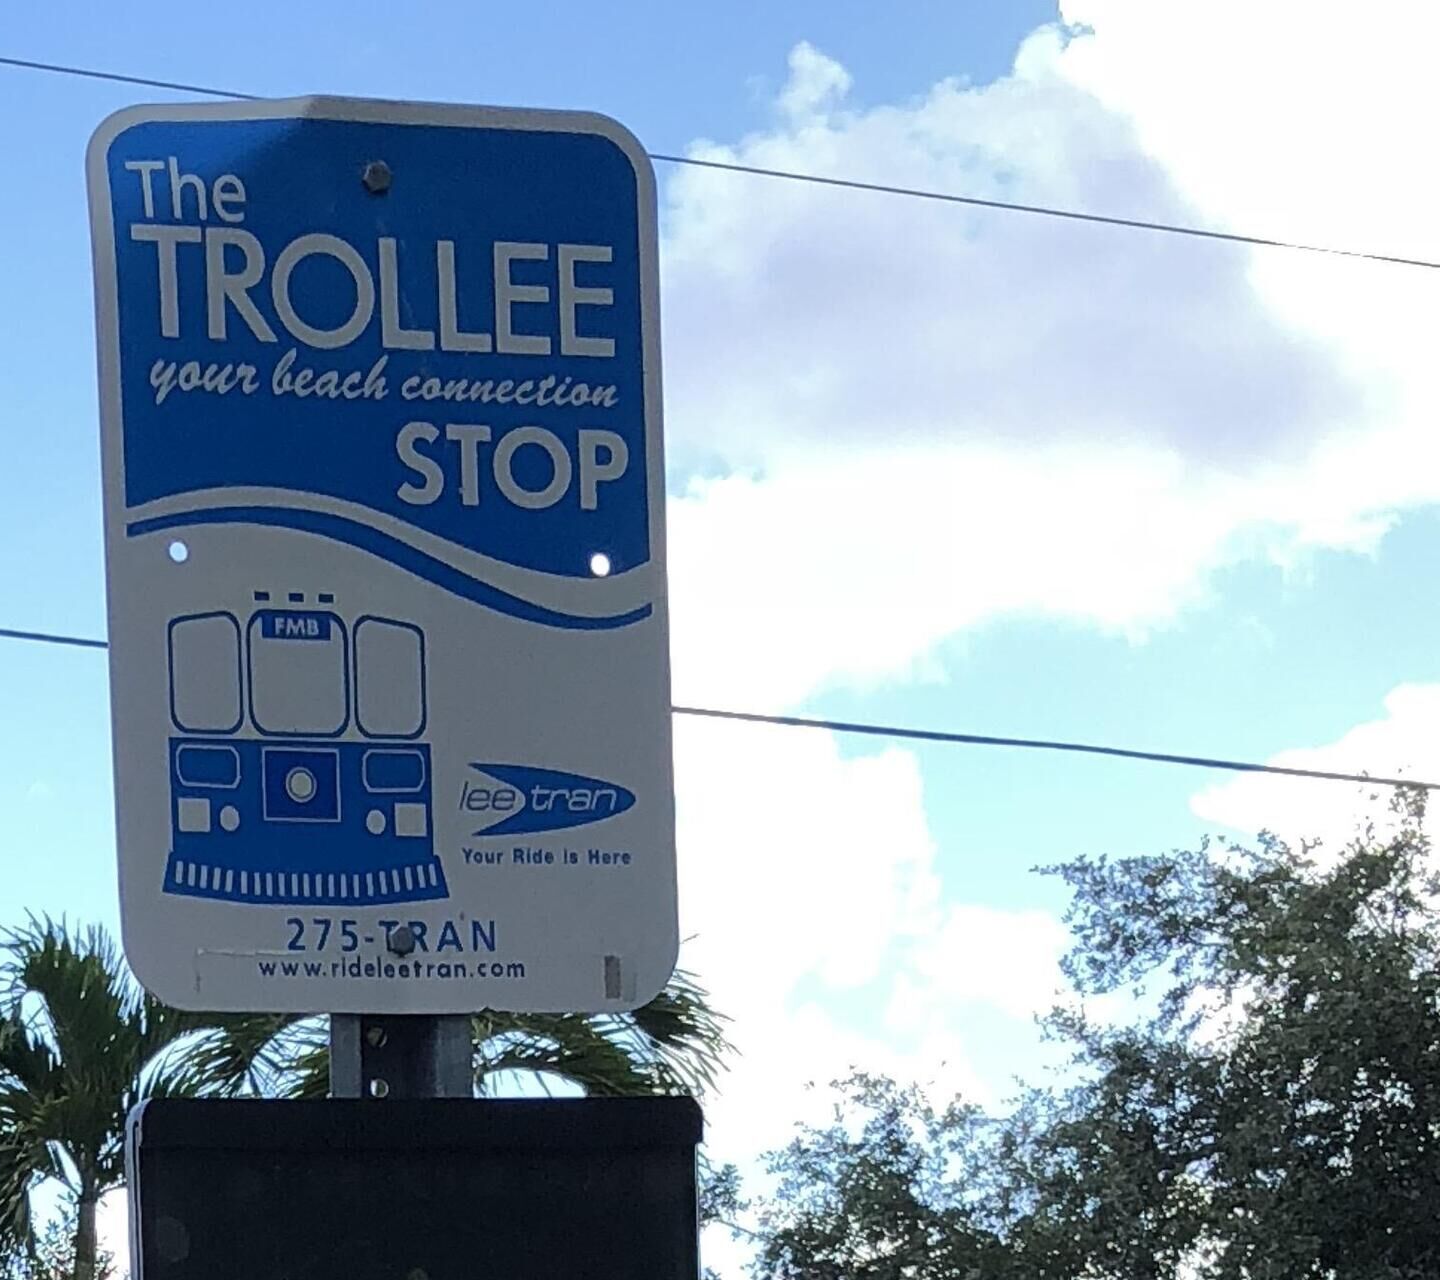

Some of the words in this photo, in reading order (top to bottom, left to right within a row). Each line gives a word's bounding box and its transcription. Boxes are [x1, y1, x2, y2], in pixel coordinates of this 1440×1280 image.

[125, 157, 246, 222] The
[130, 224, 615, 357] TROLLEE
[150, 357, 259, 404] your
[271, 349, 389, 400] beach
[401, 368, 618, 407] connection
[396, 421, 629, 510] STOP
[274, 617, 320, 637] FMB
[462, 848, 503, 864] Your
[513, 848, 554, 864] Ride
[588, 850, 631, 864] Here
[286, 918, 497, 954] 275-TRAN
[259, 956, 526, 979] www.rideleetran.com
